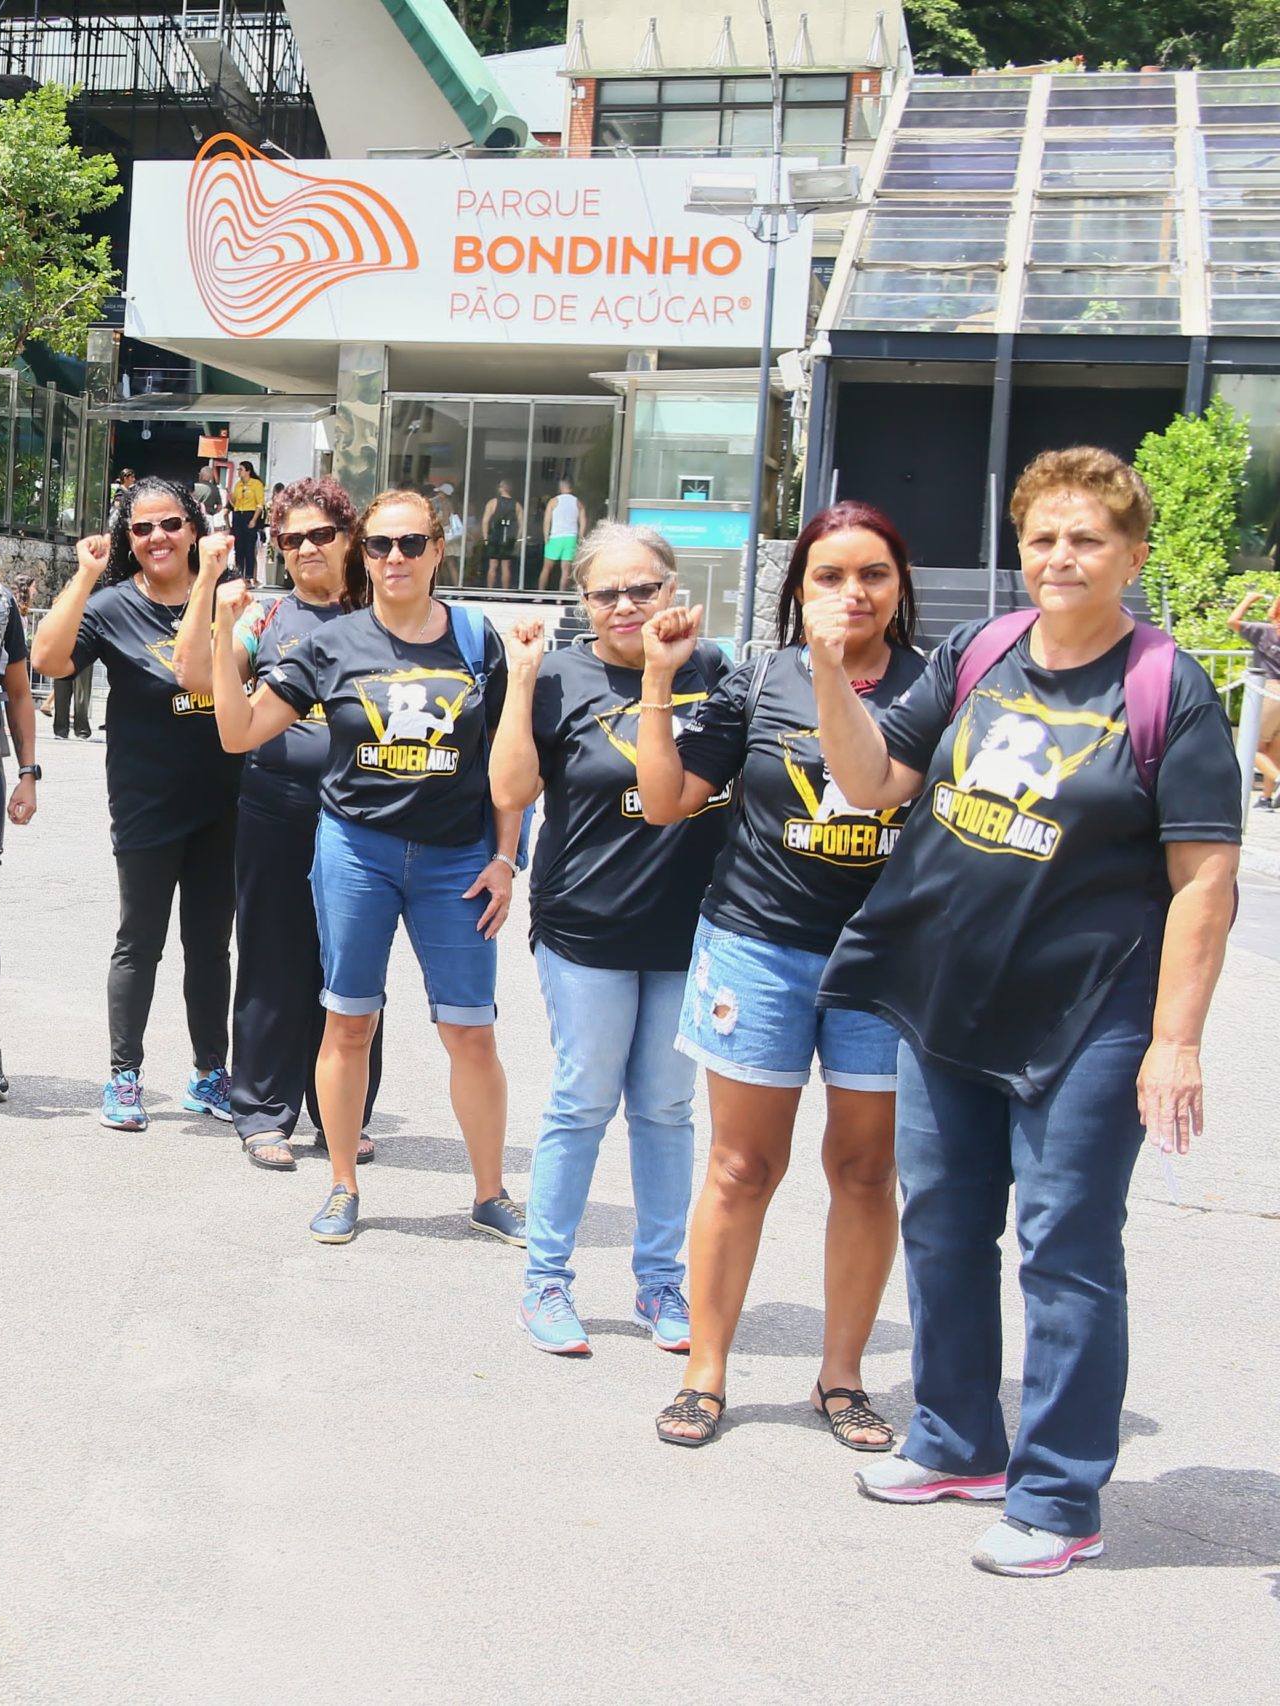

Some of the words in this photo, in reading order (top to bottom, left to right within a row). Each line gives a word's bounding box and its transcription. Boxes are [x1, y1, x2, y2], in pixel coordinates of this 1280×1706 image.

[456, 188, 601, 218] PARQUE
[453, 235, 742, 276] BONDINHO
[449, 286, 520, 321] PÃO
[533, 294, 578, 322] DE
[360, 745, 458, 772] EMPODERADAS
[936, 786, 1058, 855] EMPODERADAS
[787, 823, 901, 857] EMPODERAD
